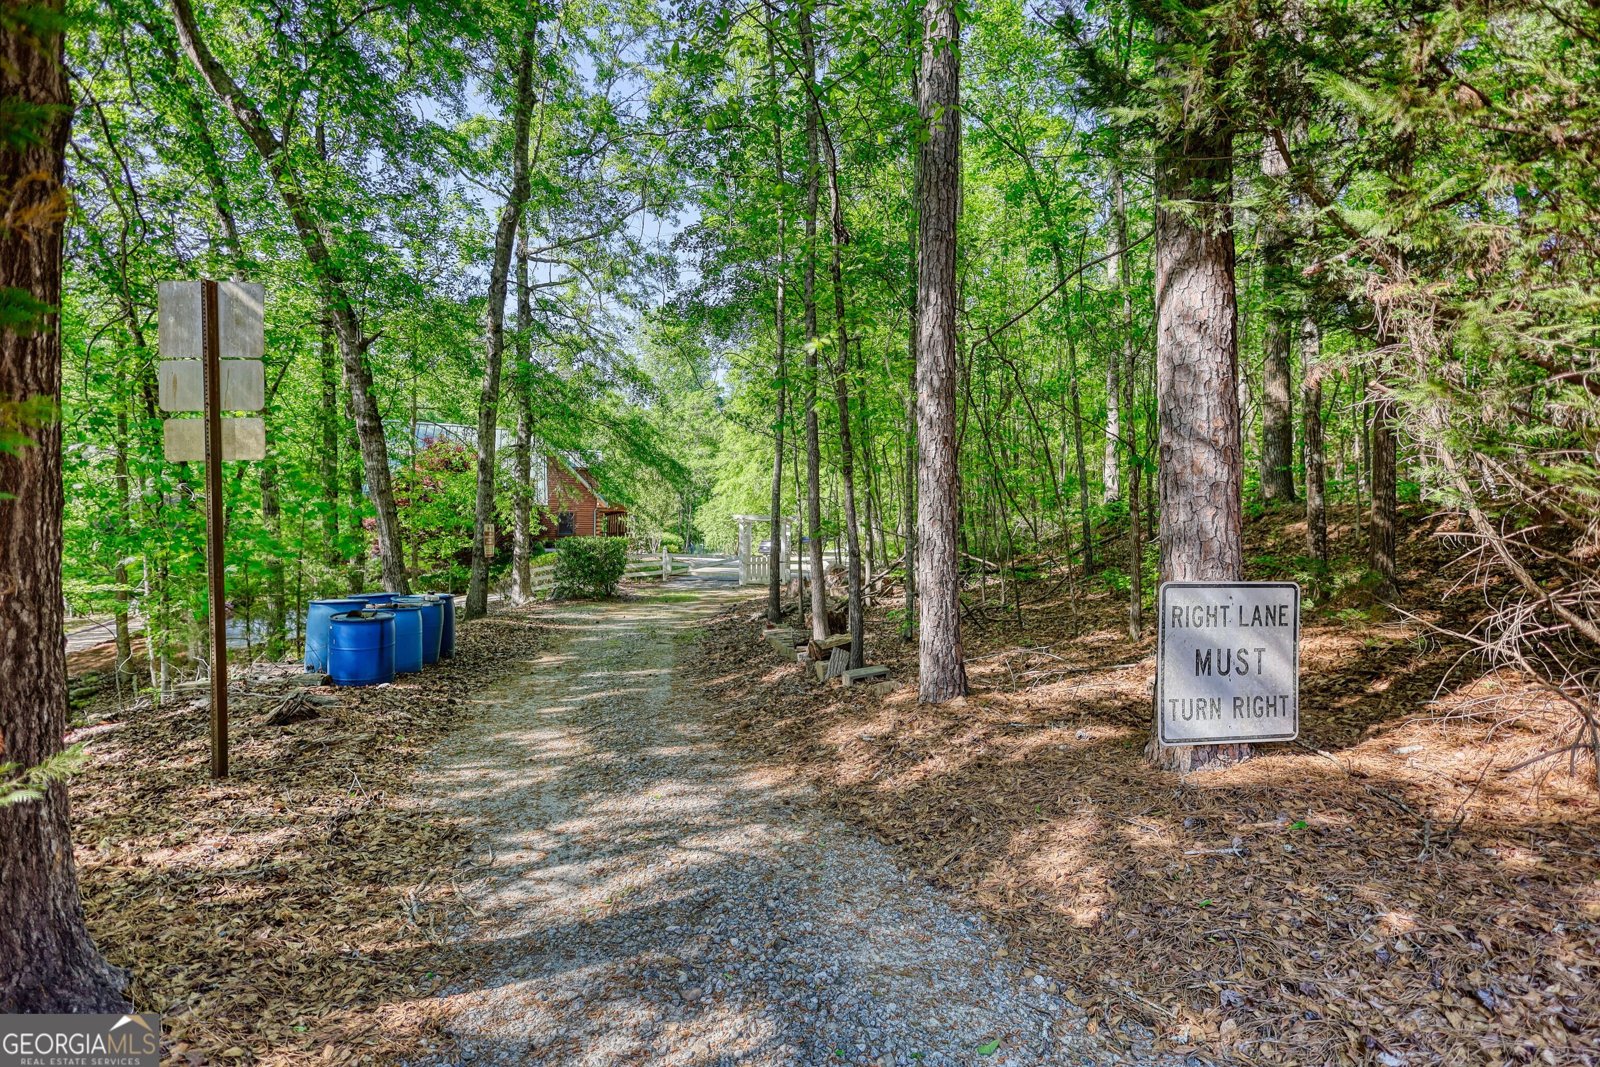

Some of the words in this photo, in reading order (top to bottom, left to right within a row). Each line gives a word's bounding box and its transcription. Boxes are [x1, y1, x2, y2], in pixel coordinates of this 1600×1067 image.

[1171, 605, 1230, 628] RIGHT
[1239, 604, 1289, 627] LANE
[1195, 647, 1266, 677] MUST
[1168, 697, 1222, 721] TURN
[1232, 695, 1289, 719] RIGHT
